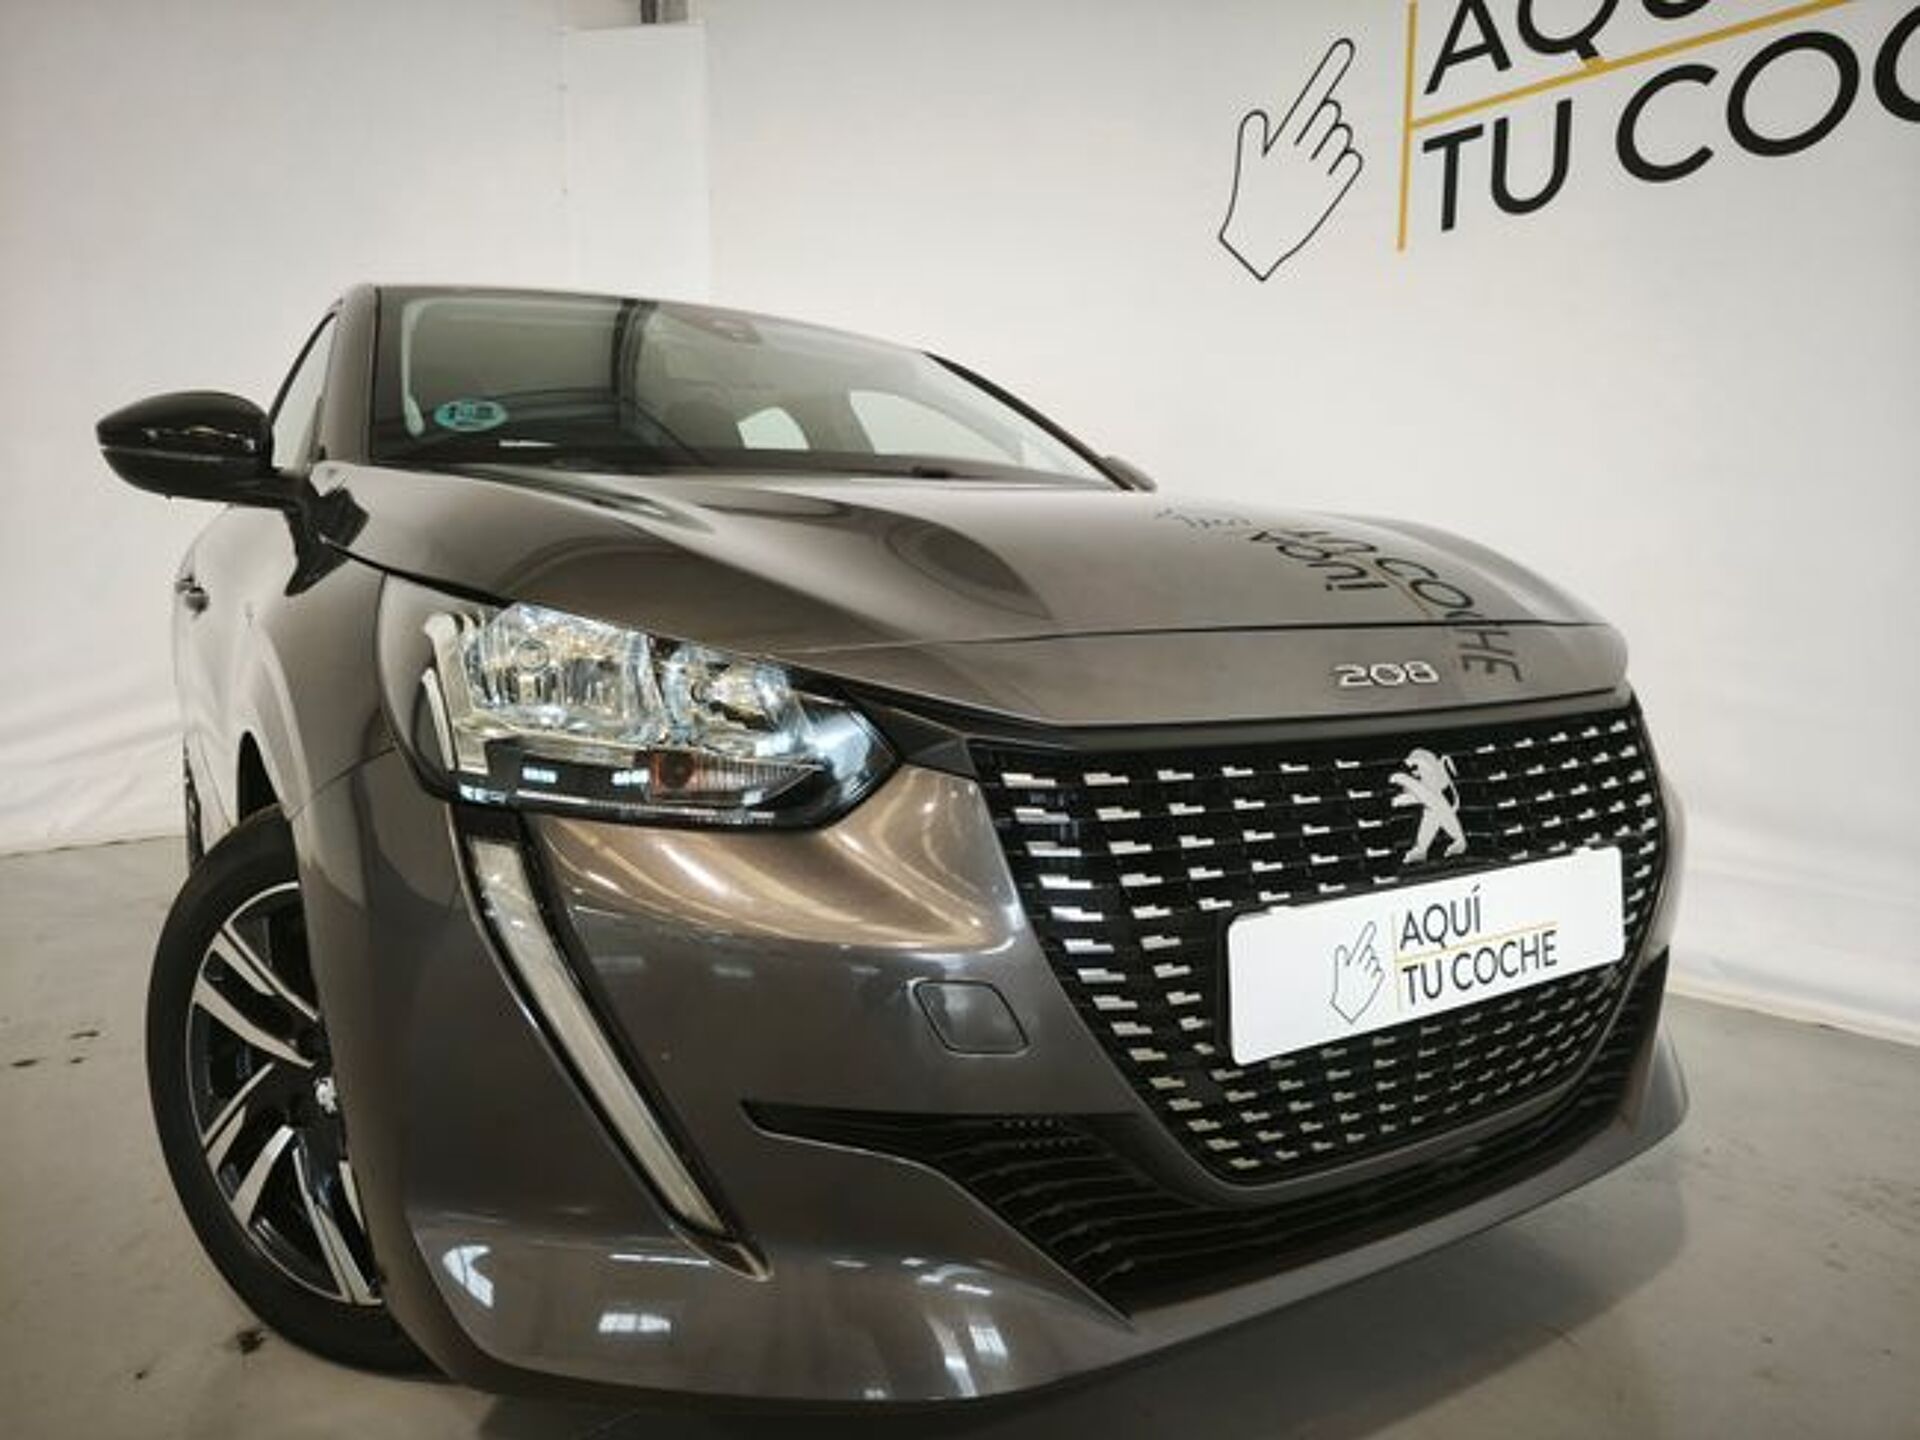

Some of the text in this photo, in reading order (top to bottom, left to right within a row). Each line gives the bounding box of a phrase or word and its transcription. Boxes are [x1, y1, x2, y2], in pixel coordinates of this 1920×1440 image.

[1422, 98, 1573, 231] TU
[1334, 660, 1439, 688] 208
[1399, 884, 1482, 950] AQUÍ
[1401, 930, 1558, 1005] TU COCHE
